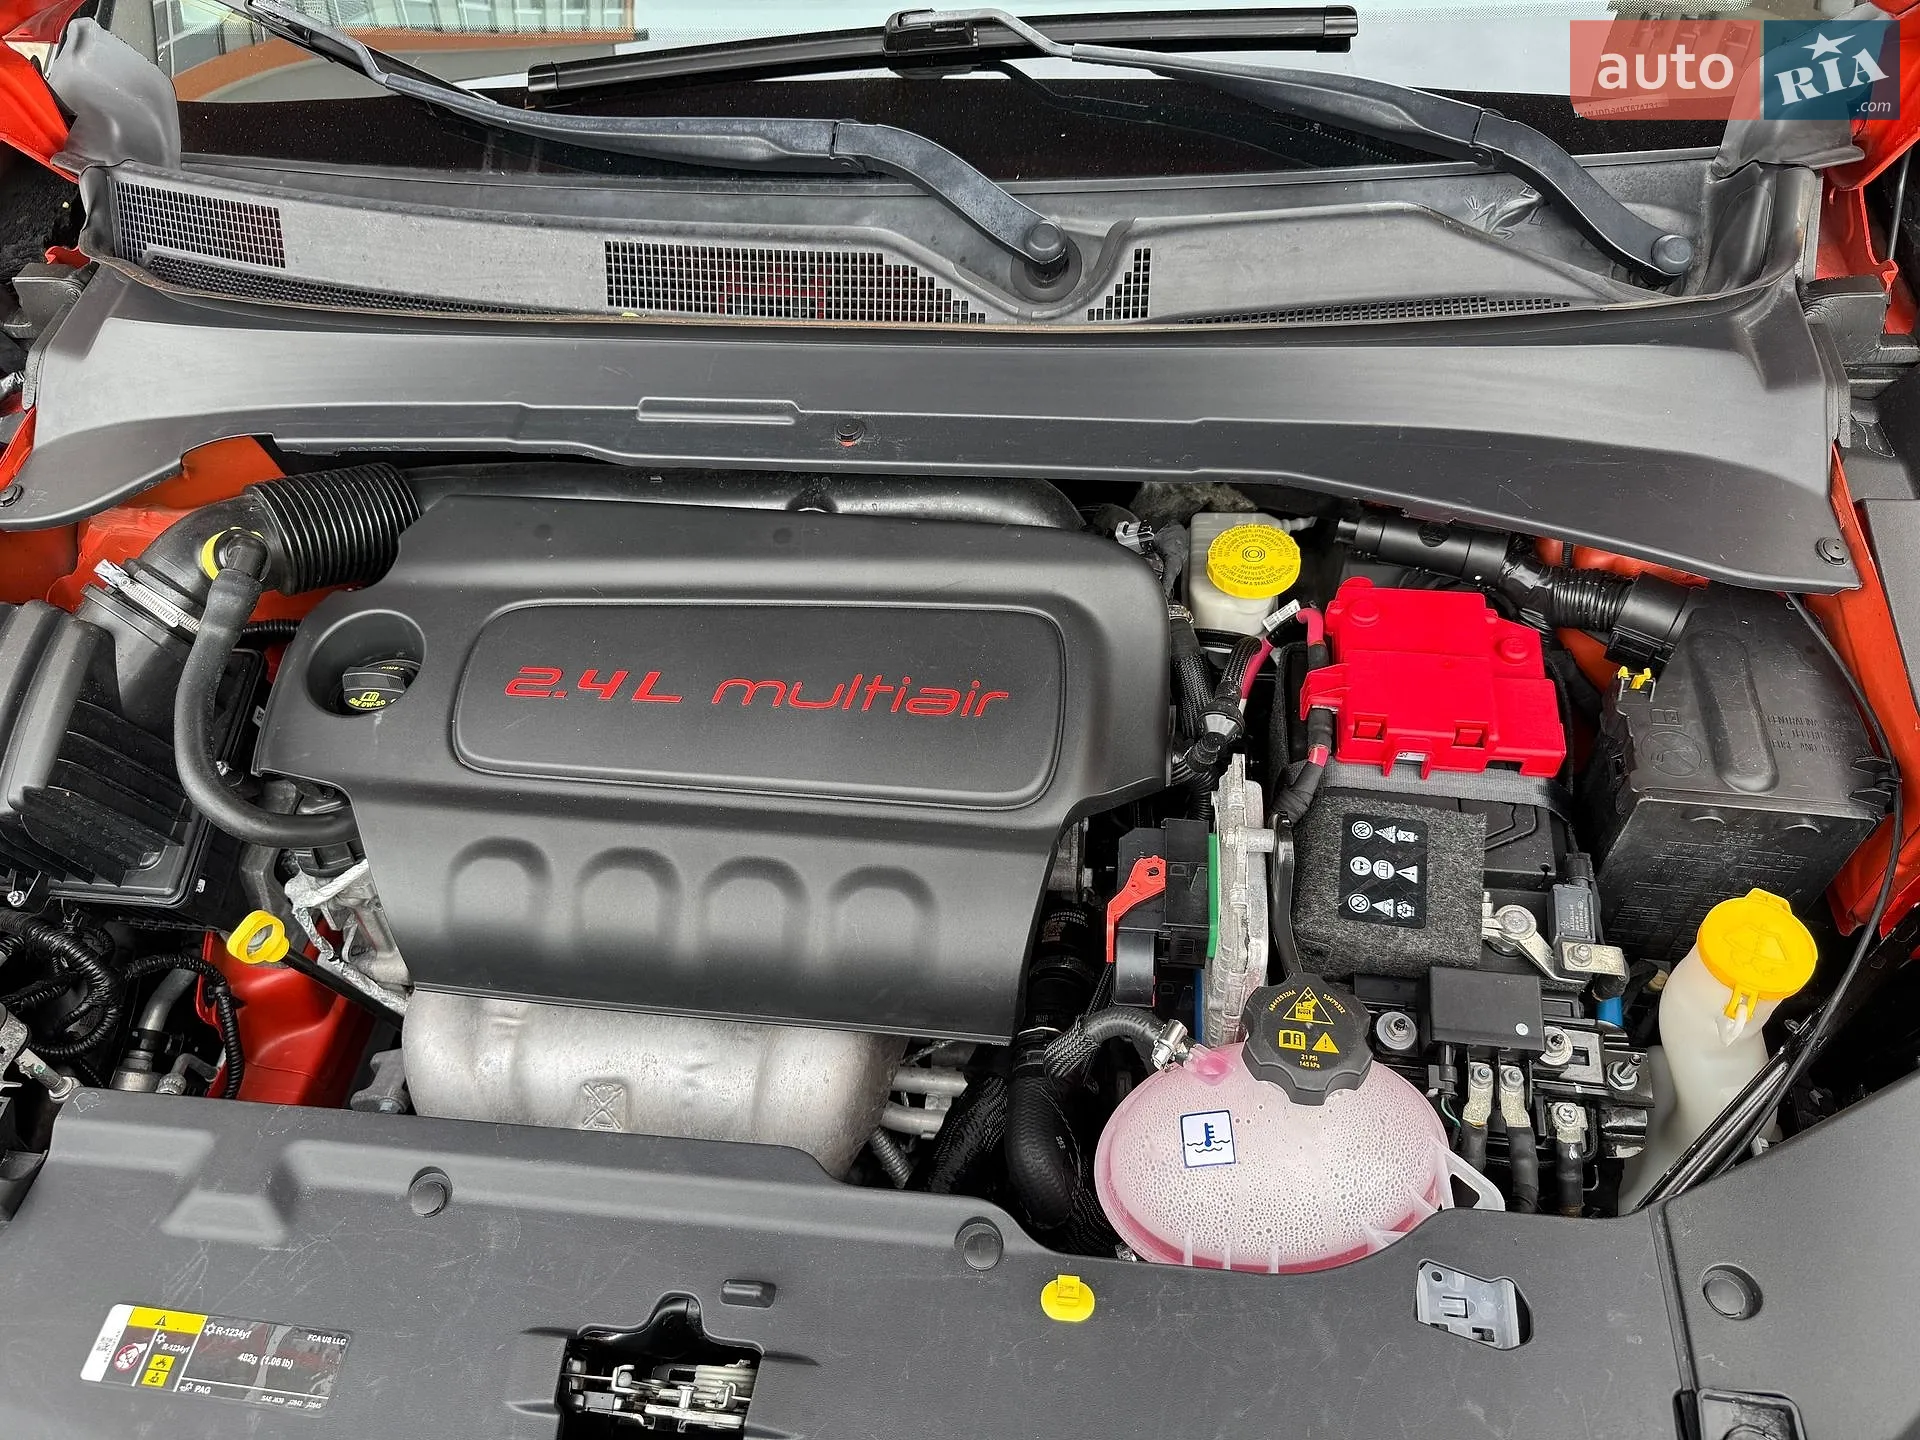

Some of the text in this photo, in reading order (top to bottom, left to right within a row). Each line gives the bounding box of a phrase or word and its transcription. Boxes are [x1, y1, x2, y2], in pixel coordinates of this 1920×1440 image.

[711, 673, 1009, 718] multiair
[216, 1327, 252, 1340] R-1234yf
[307, 1334, 346, 1345] FCA US LLC
[237, 1353, 258, 1365] 482g
[194, 1385, 211, 1395] PAG
